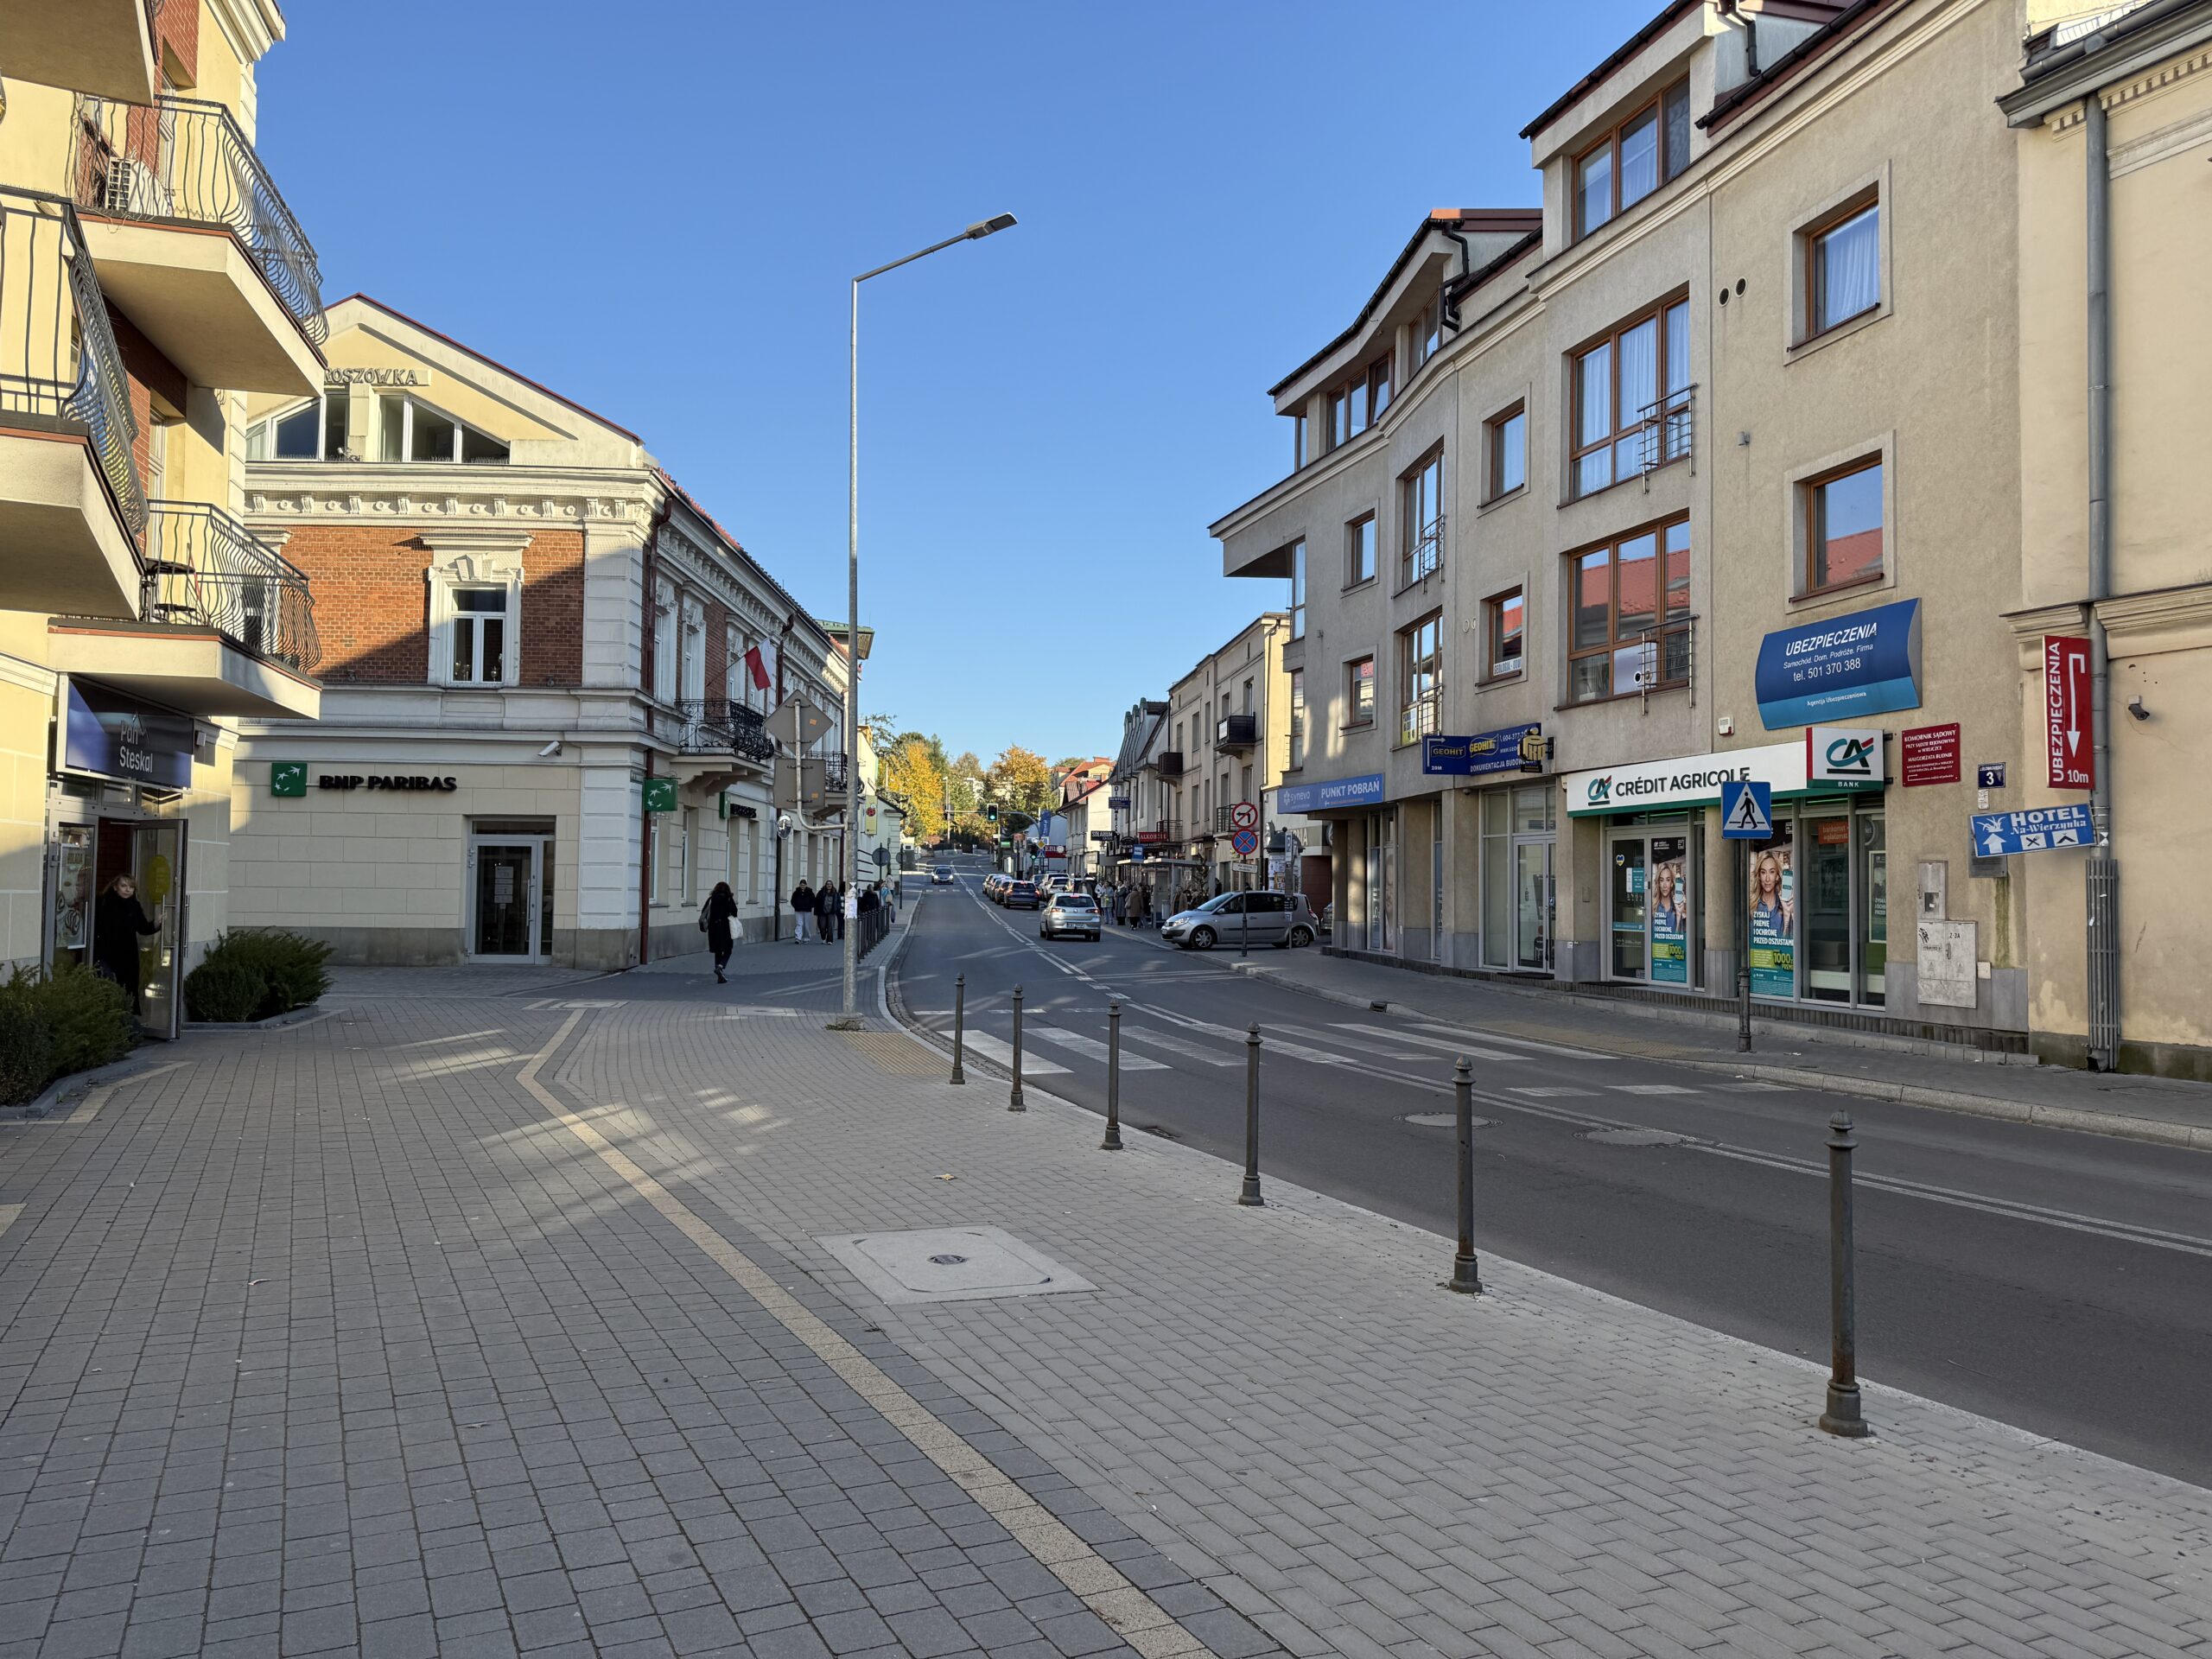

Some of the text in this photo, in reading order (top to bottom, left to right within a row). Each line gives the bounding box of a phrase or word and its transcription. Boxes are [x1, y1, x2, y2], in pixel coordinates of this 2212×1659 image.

[1785, 622, 1878, 657] UBEZPIECZENIA
[1856, 644, 1873, 653] Firma
[1793, 658, 1861, 682] tel. 501 370 388
[1807, 691, 1867, 707] Agencja Ubezpieczeniowa
[2049, 642, 2064, 782] UBEZPIECZENIA
[120, 719, 138, 745] Pan
[1904, 729, 1956, 742] KOMORNIK SĄDOWY
[1469, 739, 1497, 753] GEOHIT
[119, 745, 153, 773] Steskal
[1470, 761, 1505, 773] DOKUMENTACJA
[319, 775, 457, 791] BNP PARIBAS
[1986, 771, 1995, 785] 3
[2067, 769, 2089, 784] 10m
[1321, 777, 1380, 798] PUNKT POBRAŃ
[1615, 777, 1668, 798] CRÉDIT
[1290, 791, 1311, 804] synevo
[2010, 807, 2086, 827] HOTEL
[1753, 919, 1770, 928] PREMIĘ
[1756, 928, 1777, 938] OCHRONĘ
[1774, 951, 1790, 964] 1000
